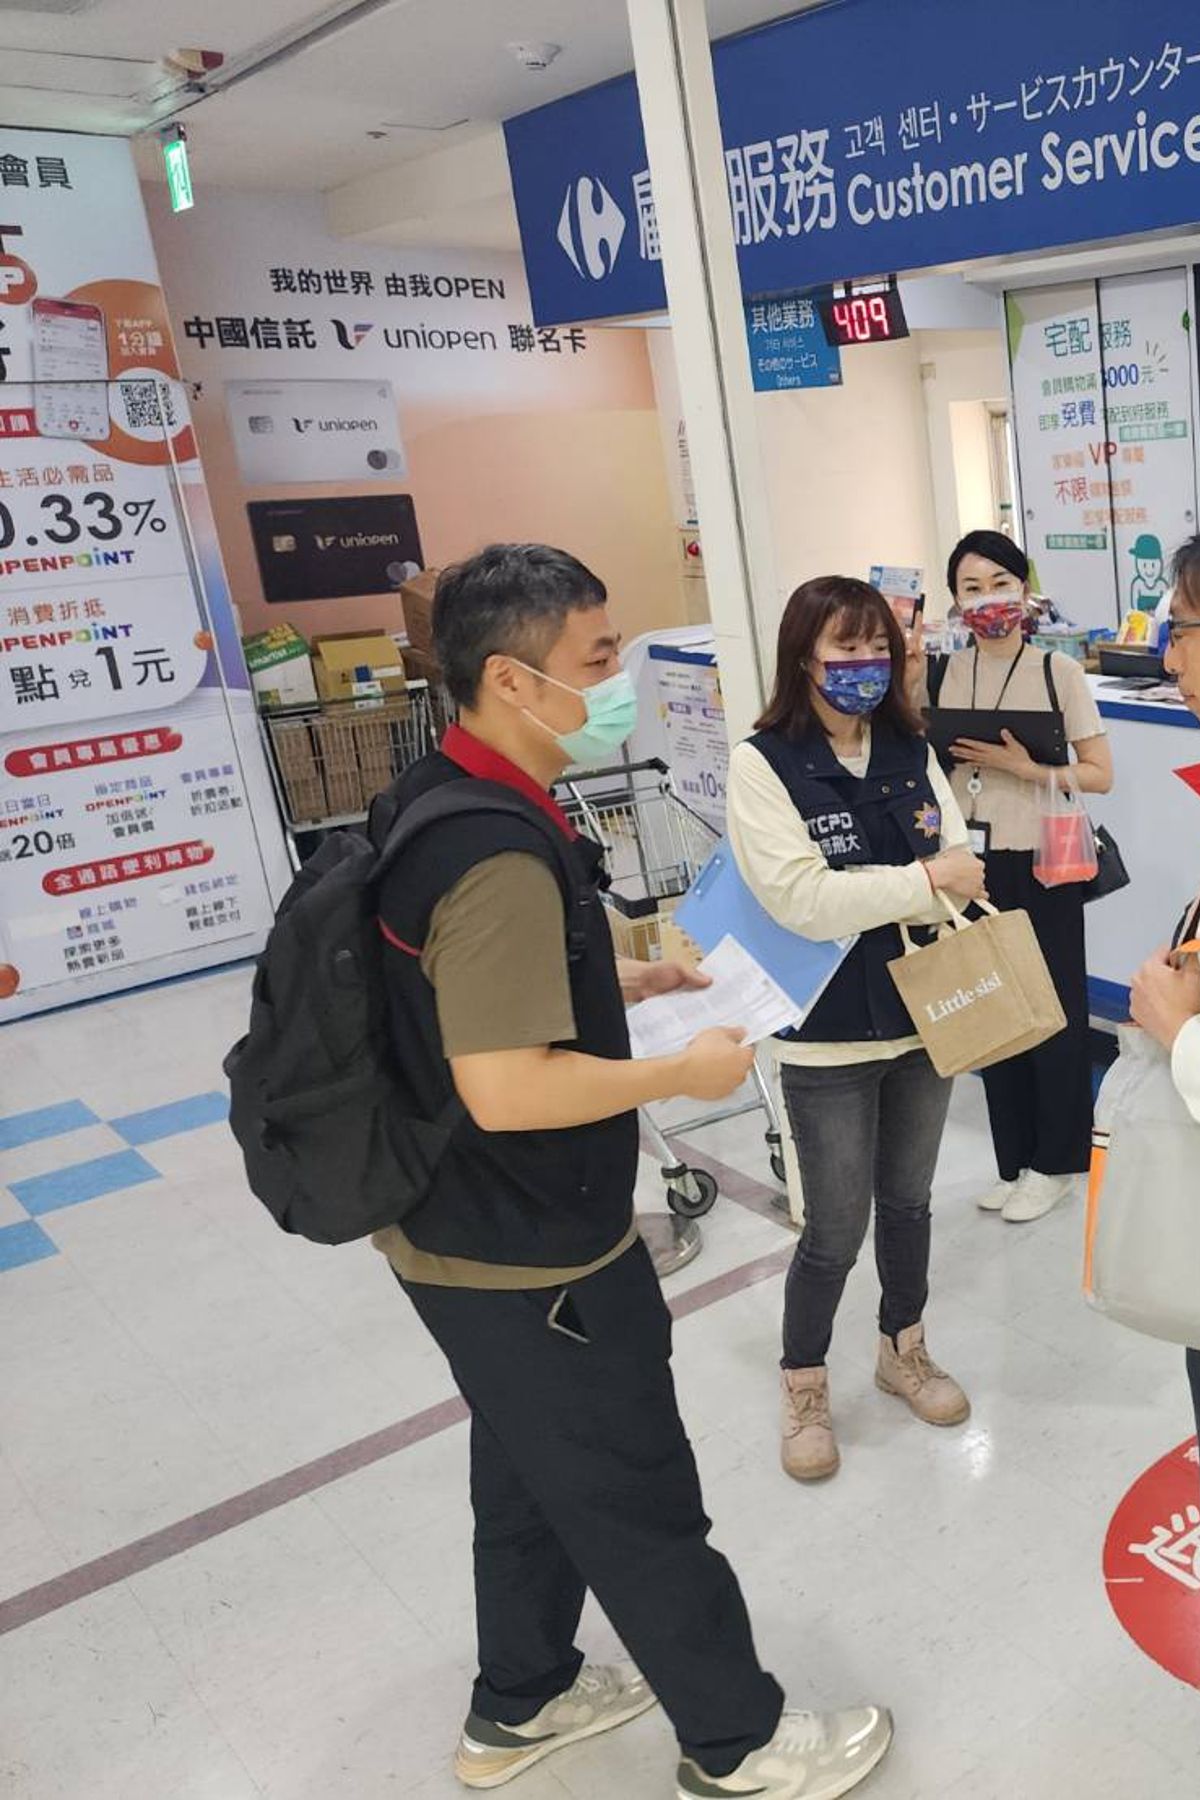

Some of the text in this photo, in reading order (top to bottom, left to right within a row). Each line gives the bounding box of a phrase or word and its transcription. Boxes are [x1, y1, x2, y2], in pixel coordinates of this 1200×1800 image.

[843, 116, 886, 158] 고객
[847, 161, 1028, 226] Customer
[269, 268, 506, 300] 我的世界 由我OPEN
[752, 297, 815, 334] 其他業務
[833, 296, 890, 340] 409
[184, 316, 587, 354] 中國信託 uniopen 聯名卡
[318, 416, 378, 433] uniopen
[340, 530, 399, 548] uniopen
[924, 989, 976, 1023] Little
